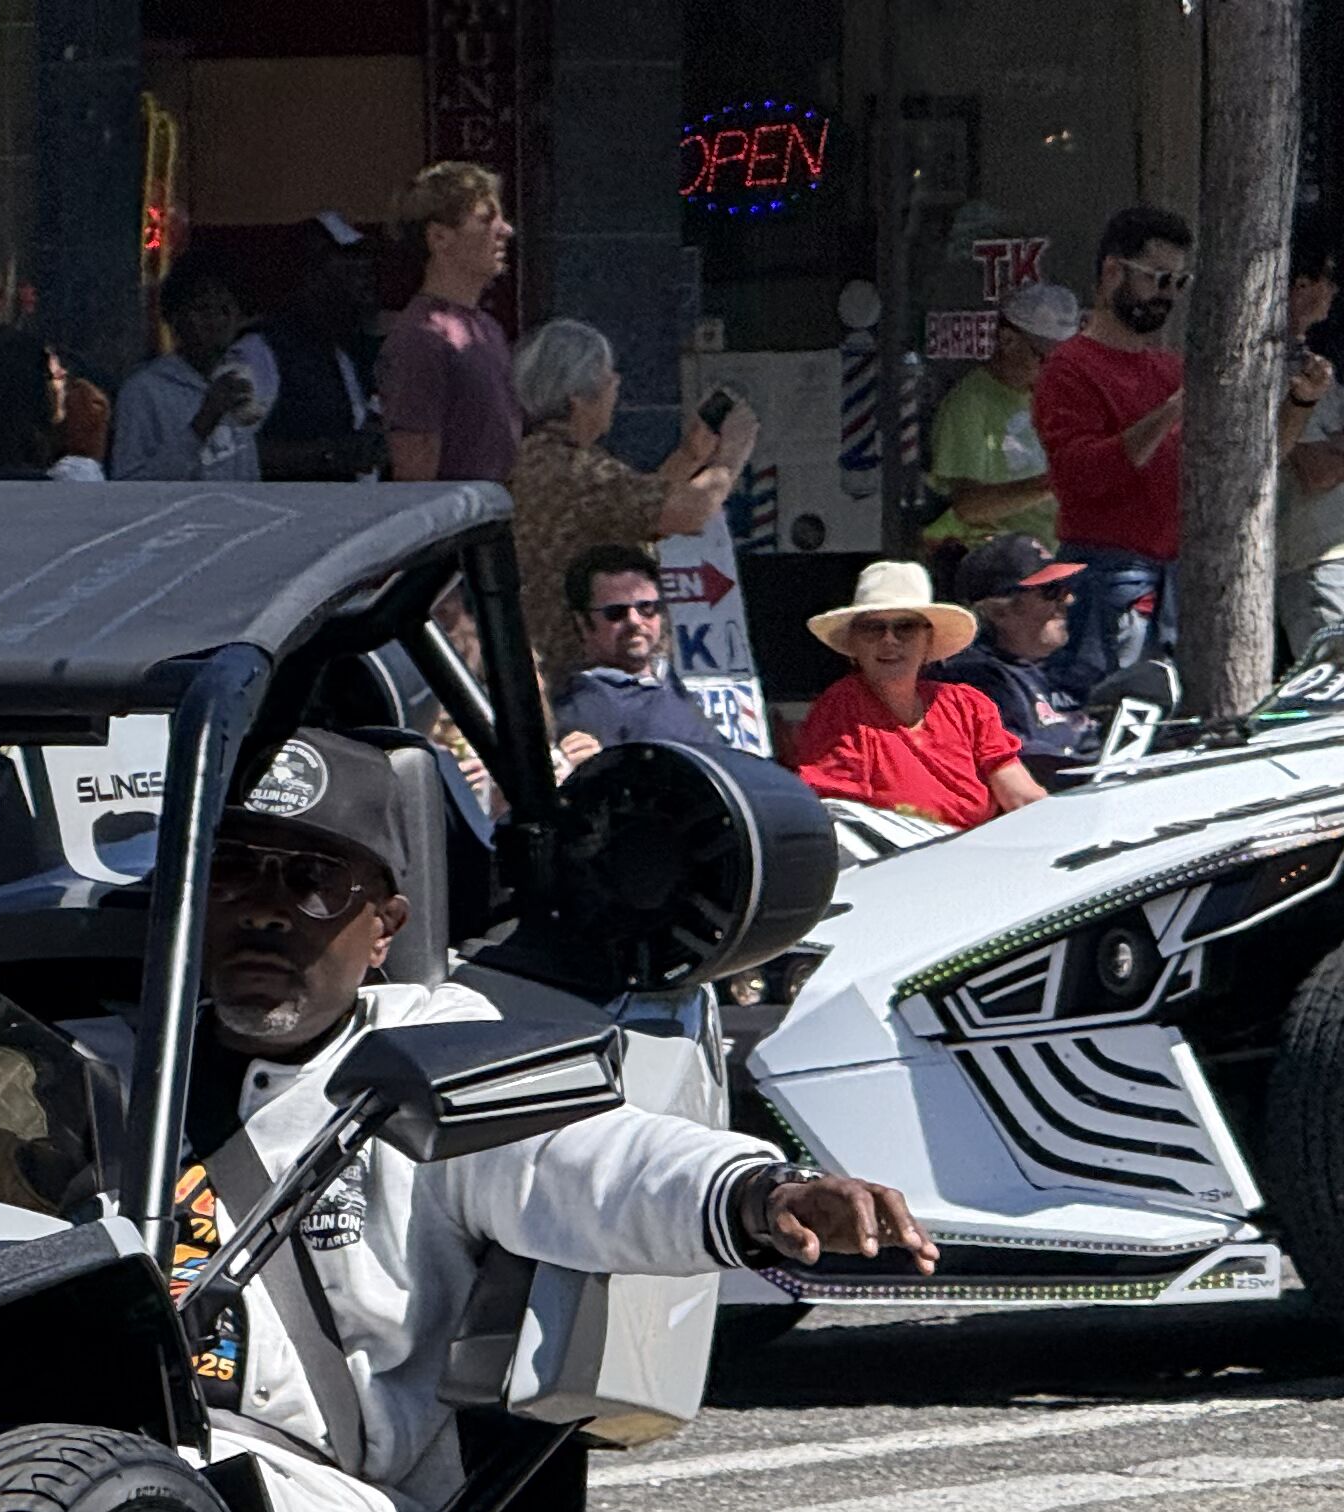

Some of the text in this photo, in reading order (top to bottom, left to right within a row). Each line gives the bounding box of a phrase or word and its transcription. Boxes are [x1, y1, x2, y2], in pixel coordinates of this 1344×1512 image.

[678, 118, 830, 195] OPEN
[973, 237, 1049, 303] TK
[661, 572, 703, 598] EN
[77, 771, 164, 803] SLINGS
[338, 1213, 361, 1231] ON
[326, 1231, 358, 1248] AREA
[192, 1353, 234, 1382] 25
